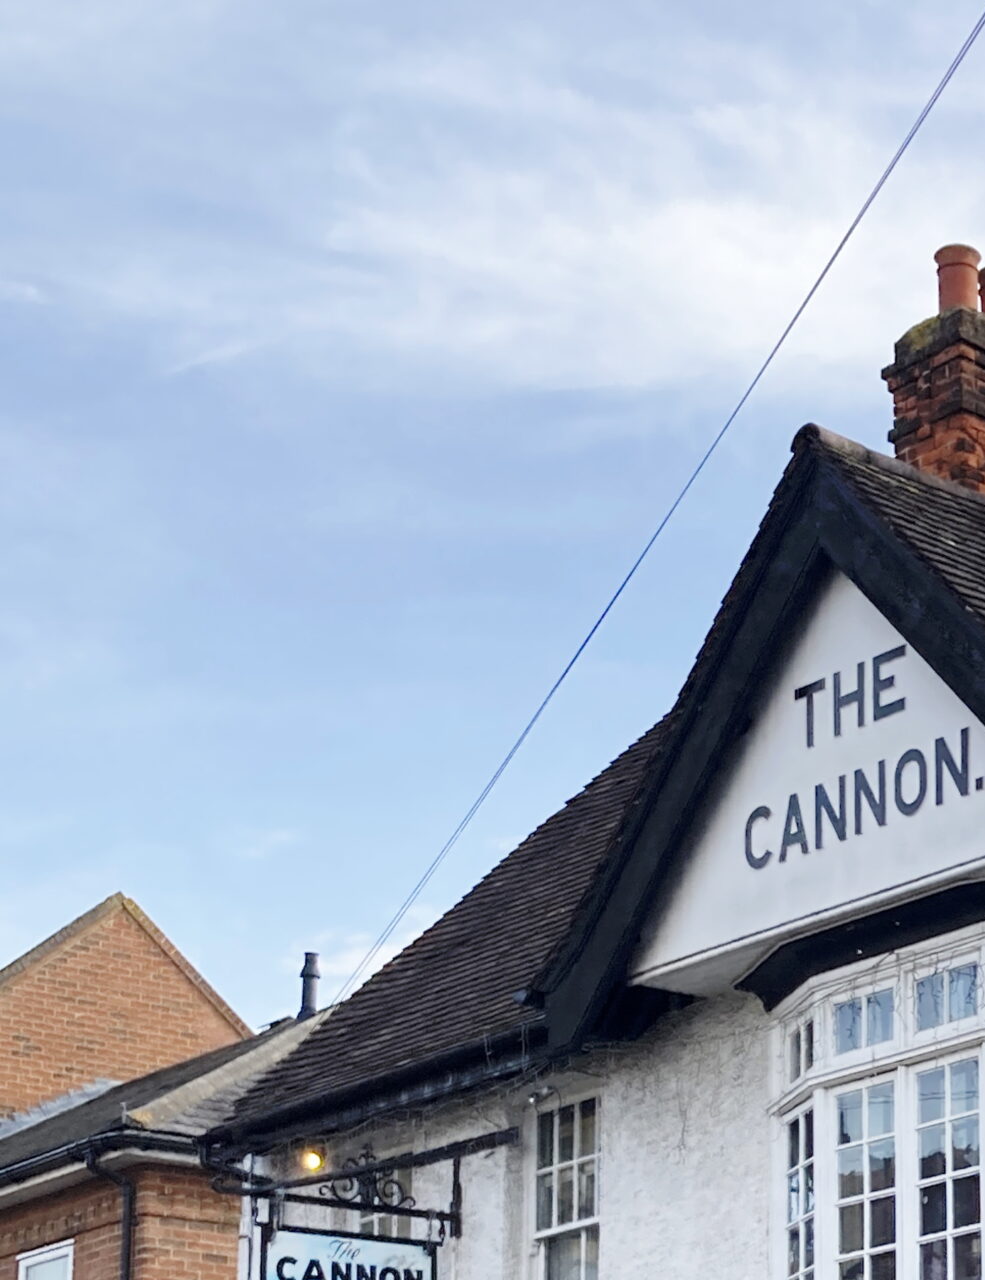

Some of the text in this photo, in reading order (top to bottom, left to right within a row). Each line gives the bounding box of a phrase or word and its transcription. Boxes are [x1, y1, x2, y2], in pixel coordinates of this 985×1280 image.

[794, 643, 907, 748] THE
[743, 726, 985, 871] CANNON.
[326, 1238, 361, 1261] The
